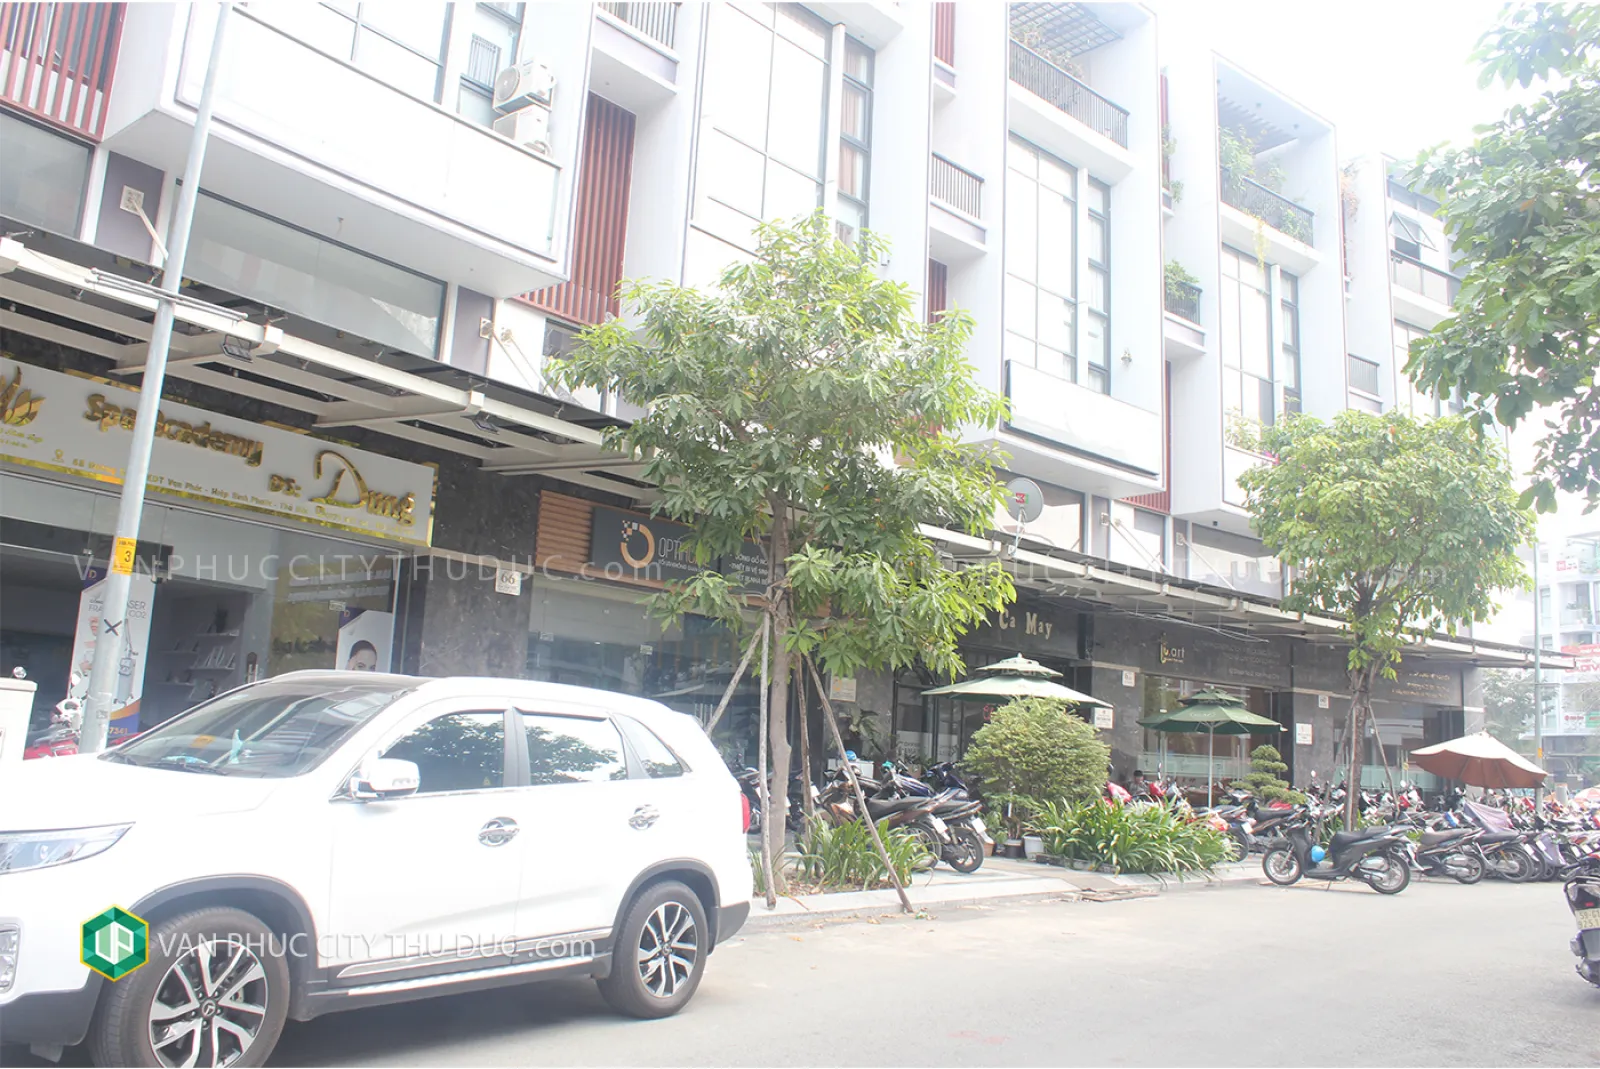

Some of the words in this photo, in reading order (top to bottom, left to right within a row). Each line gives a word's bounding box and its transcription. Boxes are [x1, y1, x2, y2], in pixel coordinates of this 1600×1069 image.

[124, 550, 132, 563] 3
[501, 572, 515, 584] 66
[999, 608, 1016, 630] Ca
[1025, 611, 1052, 640] May
